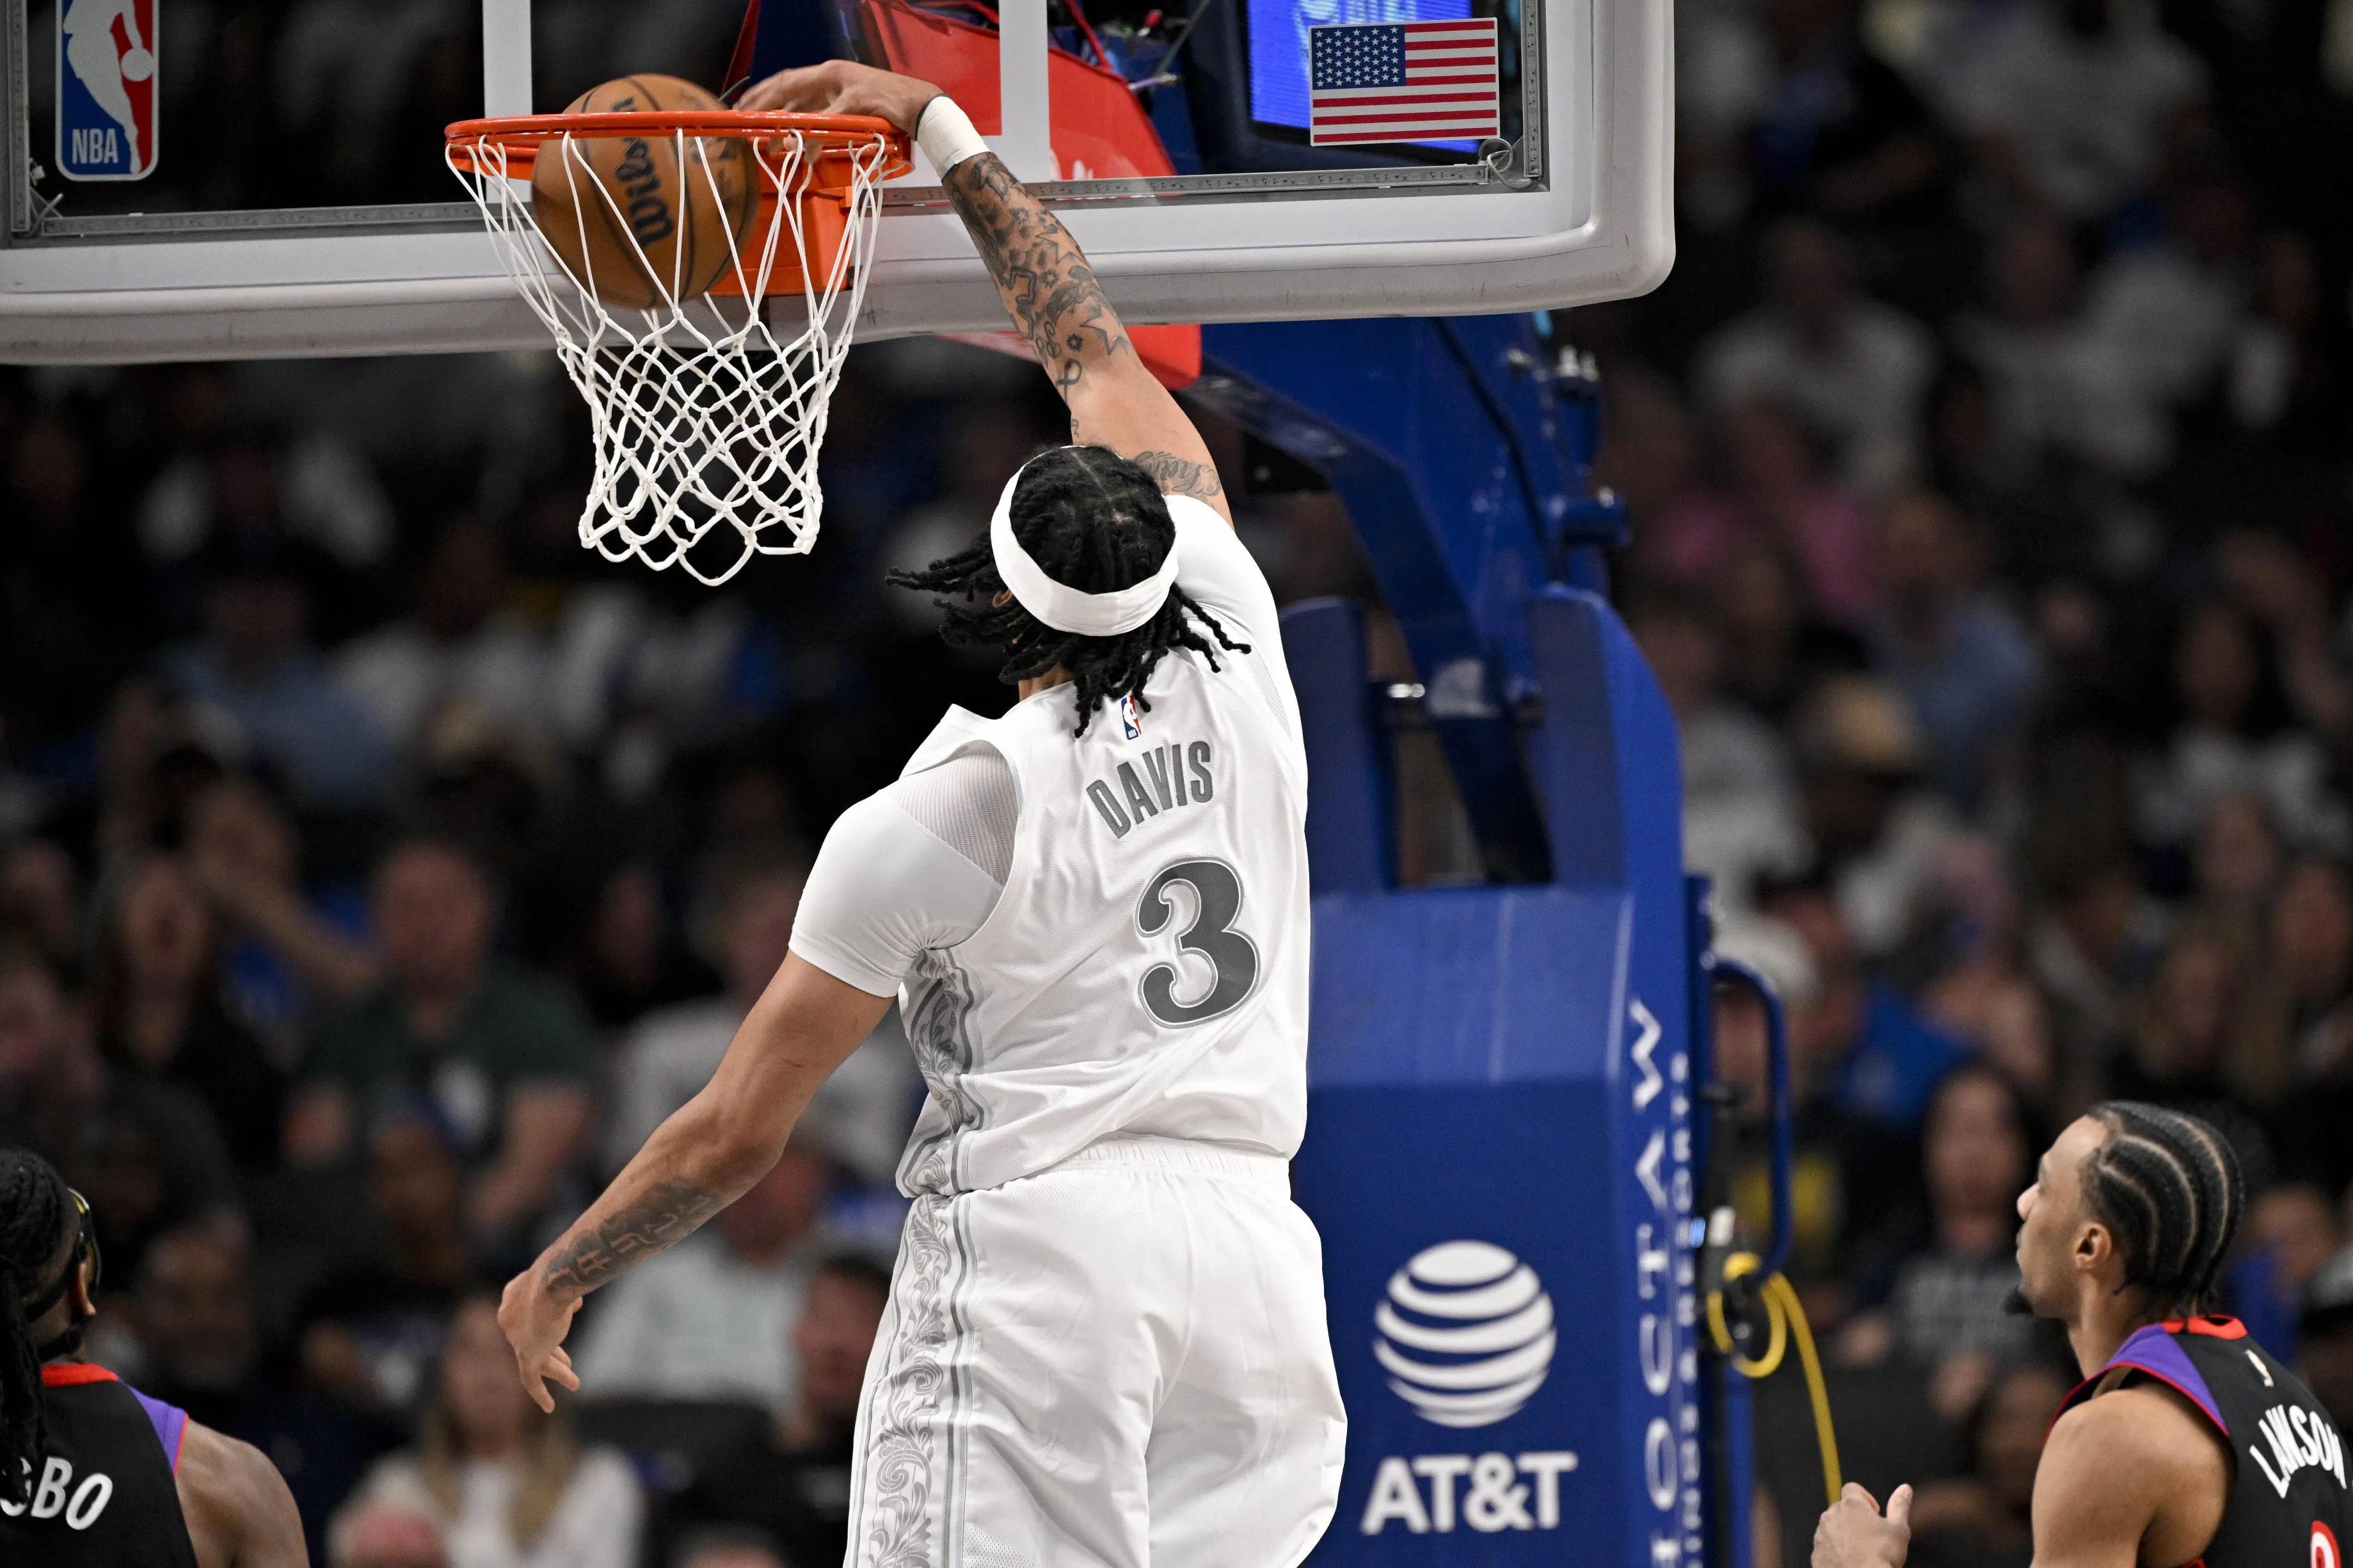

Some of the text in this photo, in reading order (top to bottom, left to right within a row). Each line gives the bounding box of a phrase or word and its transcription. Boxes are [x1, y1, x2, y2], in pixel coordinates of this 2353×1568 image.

[72, 128, 119, 164] NBA
[609, 96, 675, 251] Wils
[1086, 740, 1214, 839] DAVIS
[1135, 856, 1261, 1029] 3
[1360, 1450, 1579, 1535] AT&T
[2249, 1404, 2347, 1499] LAWSON
